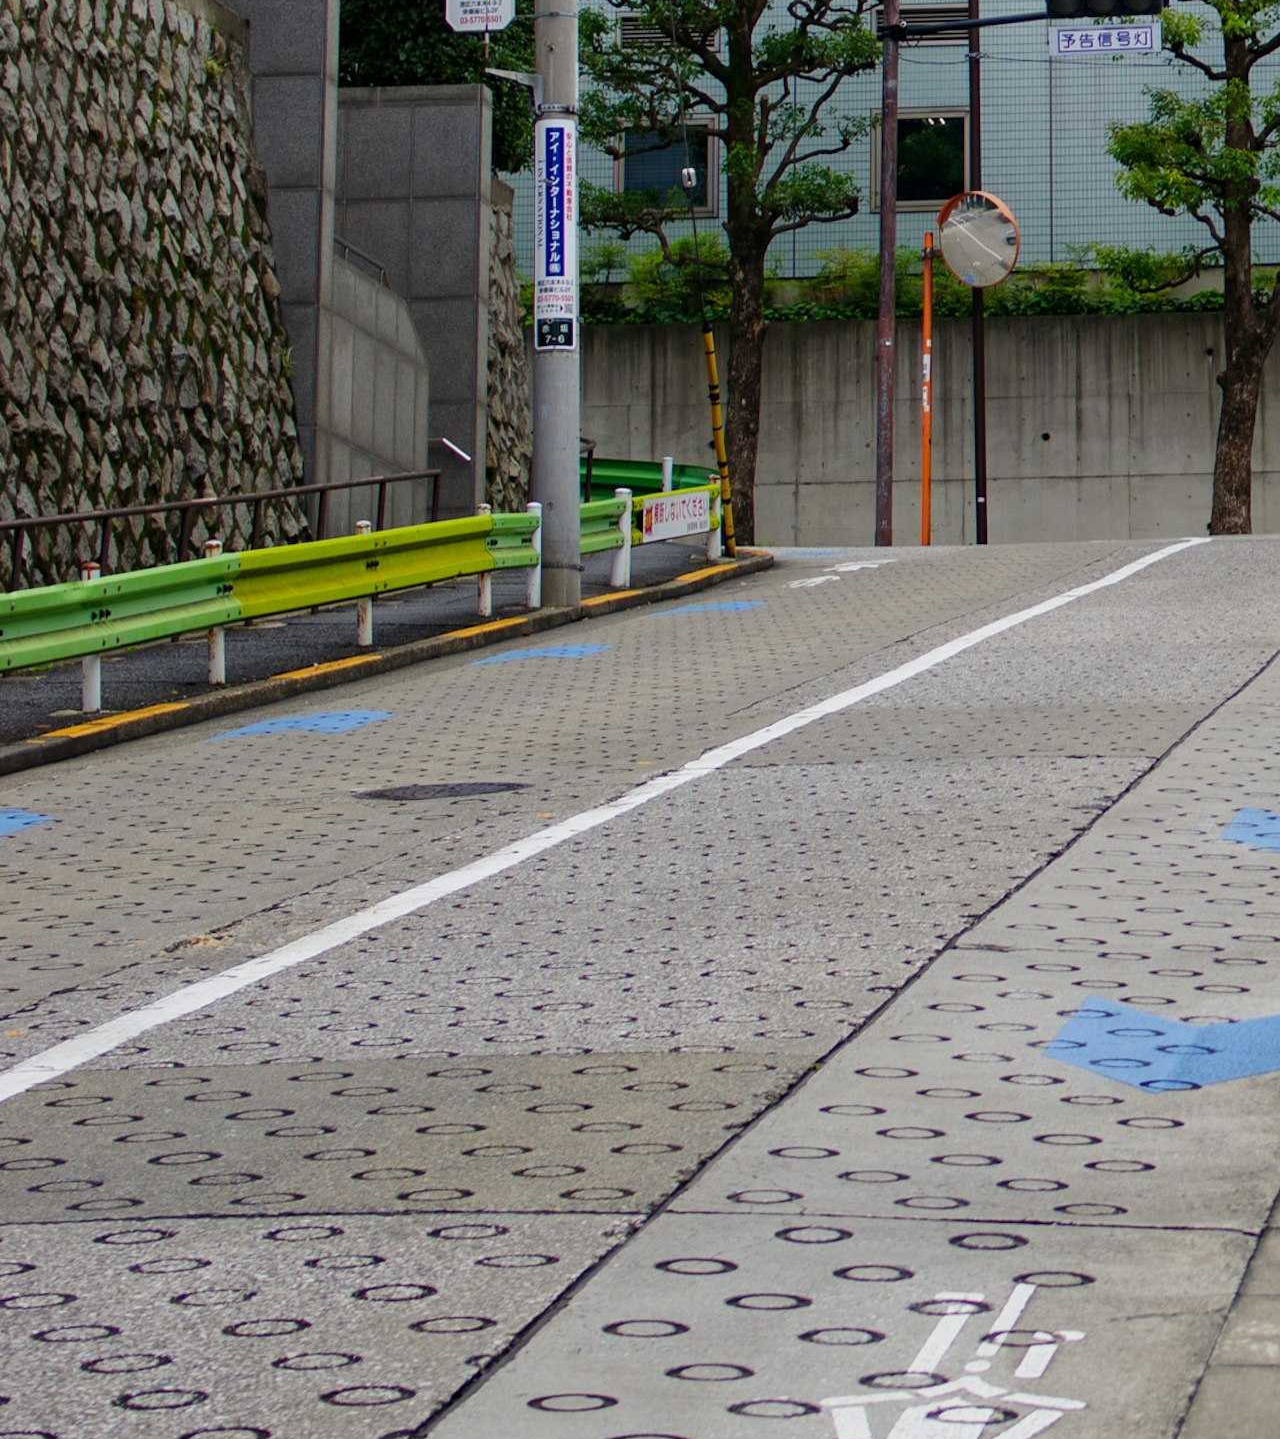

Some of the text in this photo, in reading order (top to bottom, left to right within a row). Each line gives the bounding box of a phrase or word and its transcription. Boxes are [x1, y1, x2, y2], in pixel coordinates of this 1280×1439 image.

[460, 15, 502, 24] 03-5770-5501
[1061, 31, 1149, 48] 予告信号灯
[545, 334, 565, 344] 7-6
[654, 496, 707, 525] 横断しないでください
